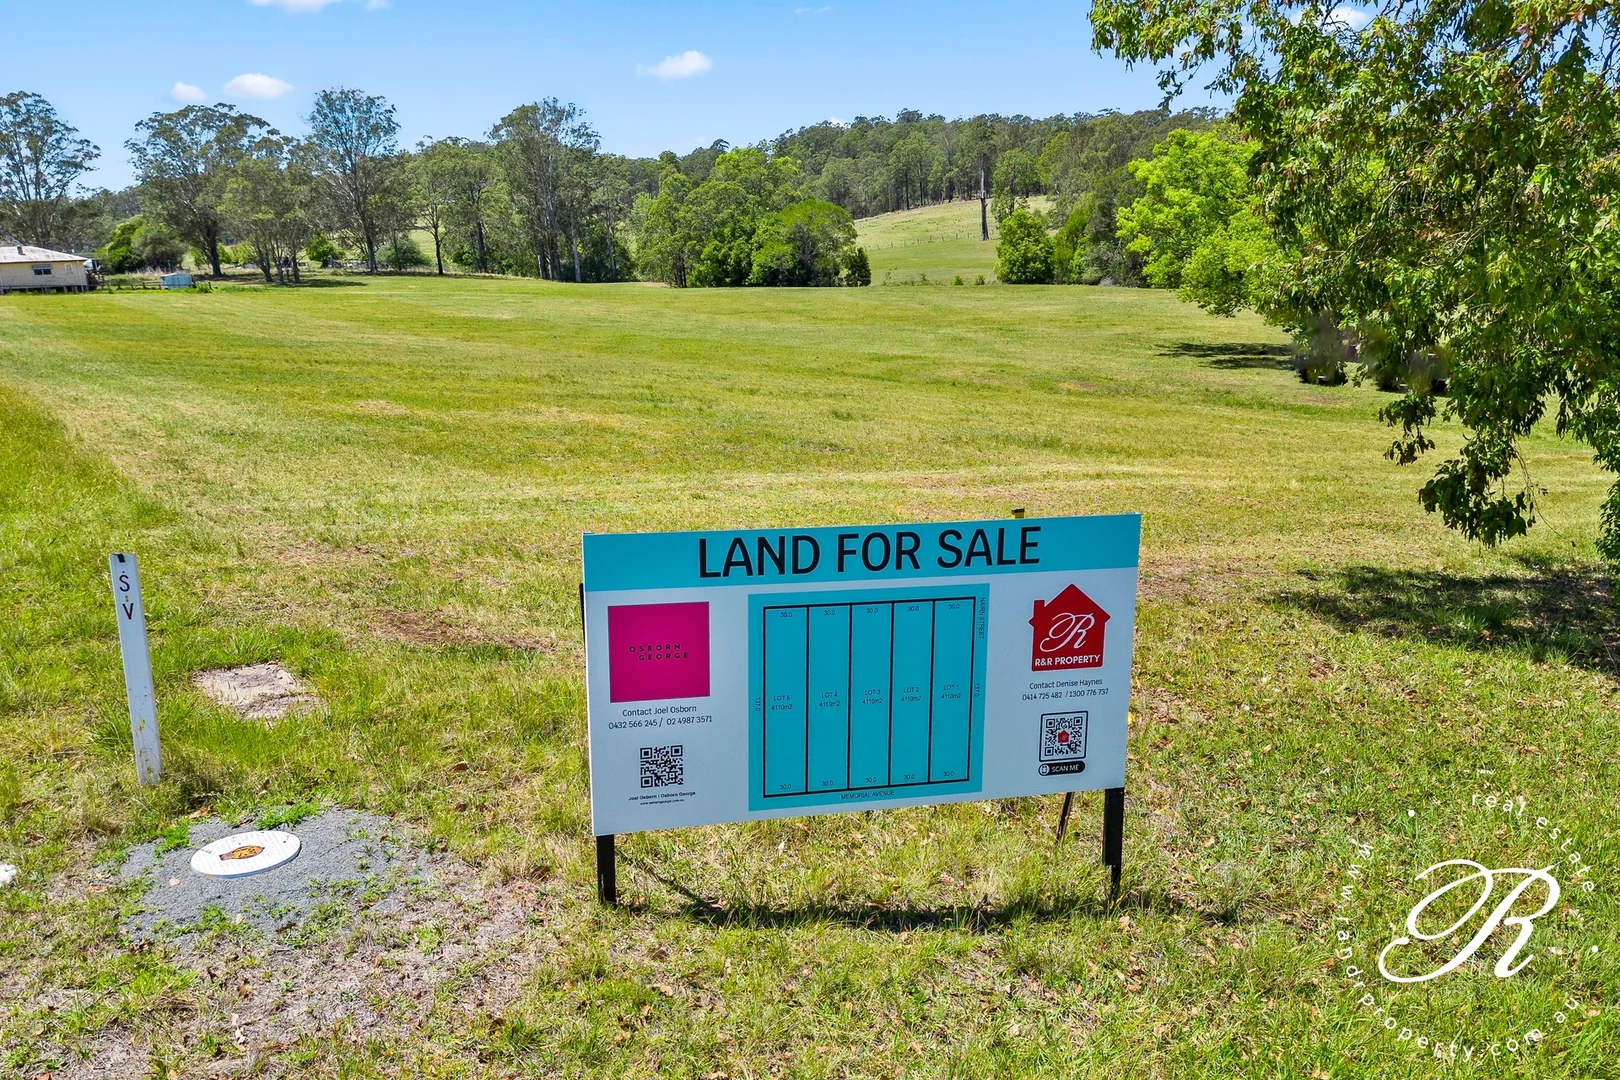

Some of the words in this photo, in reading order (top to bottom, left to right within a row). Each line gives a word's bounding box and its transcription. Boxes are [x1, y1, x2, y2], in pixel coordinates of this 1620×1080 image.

[699, 534, 820, 578] LAND
[836, 531, 921, 573] FOR
[936, 526, 1042, 569] SALE
[629, 644, 681, 653] OSBORN
[638, 651, 689, 661] GEORGE
[1034, 657, 1053, 667] R&R
[1054, 655, 1101, 665] PROPERTY
[1029, 682, 1055, 690] Contact
[1056, 680, 1079, 688] Denise
[1079, 678, 1103, 688] Haynes
[1022, 693, 1037, 701] 0414
[1038, 692, 1050, 700] 725
[1050, 691, 1063, 699] 482
[1069, 689, 1085, 697] 1300
[622, 708, 652, 717] Contact
[653, 706, 669, 715] Joel
[670, 705, 697, 714] Osborn
[608, 721, 627, 730] 0432
[629, 720, 643, 728] 566
[644, 719, 658, 727] 245
[666, 718, 676, 726] 02
[677, 716, 695, 724] 4987
[696, 715, 713, 724] 3571
[1051, 765, 1069, 773] SCAN
[841, 792, 871, 800] MEMORIAL
